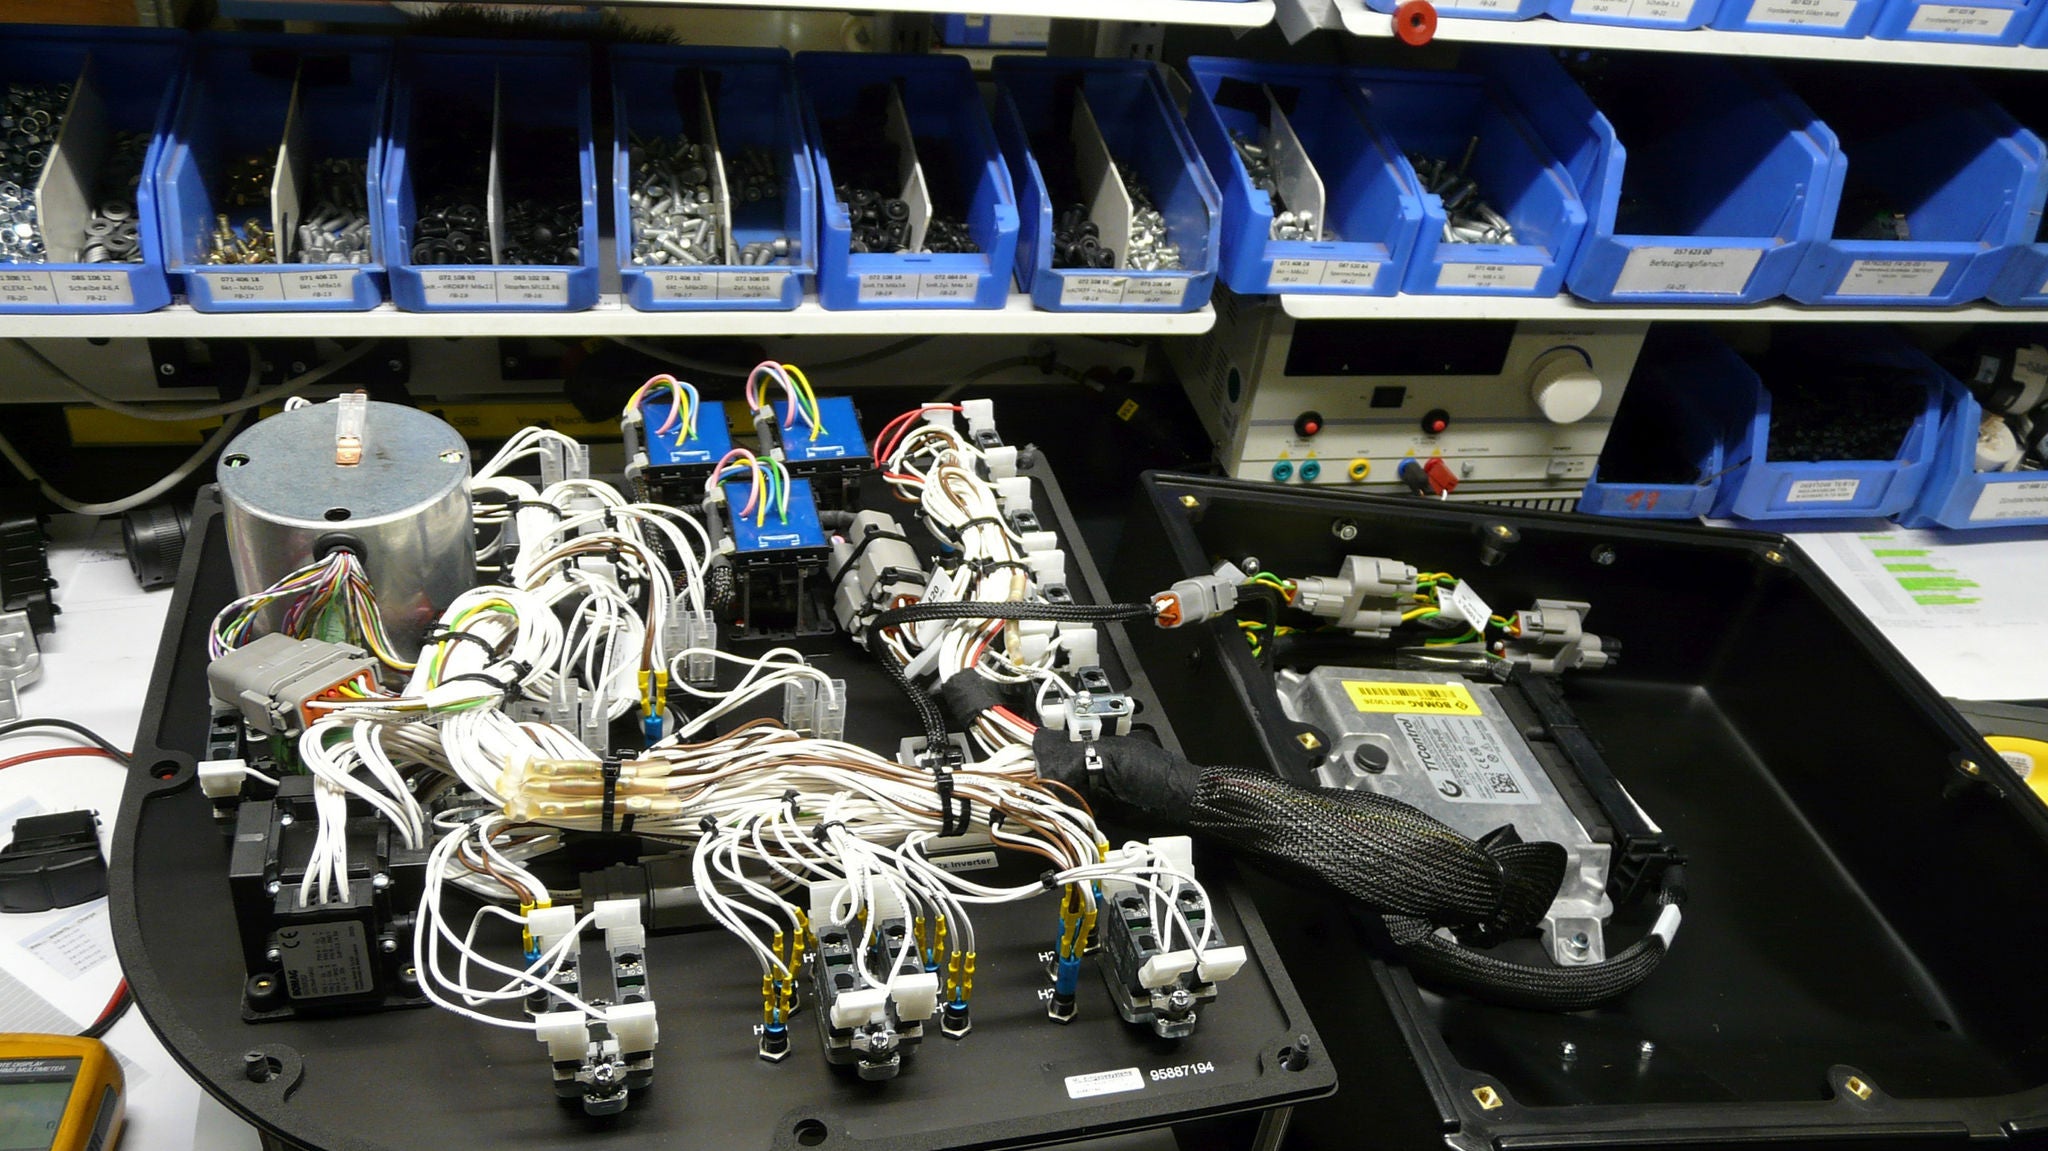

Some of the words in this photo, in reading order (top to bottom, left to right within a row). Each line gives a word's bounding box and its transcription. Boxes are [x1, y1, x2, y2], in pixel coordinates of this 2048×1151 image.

[1410, 700, 1452, 709] BOMAG
[16, 1065, 66, 1073] MULTIMETER
[1150, 1061, 1215, 1081] 95887194
